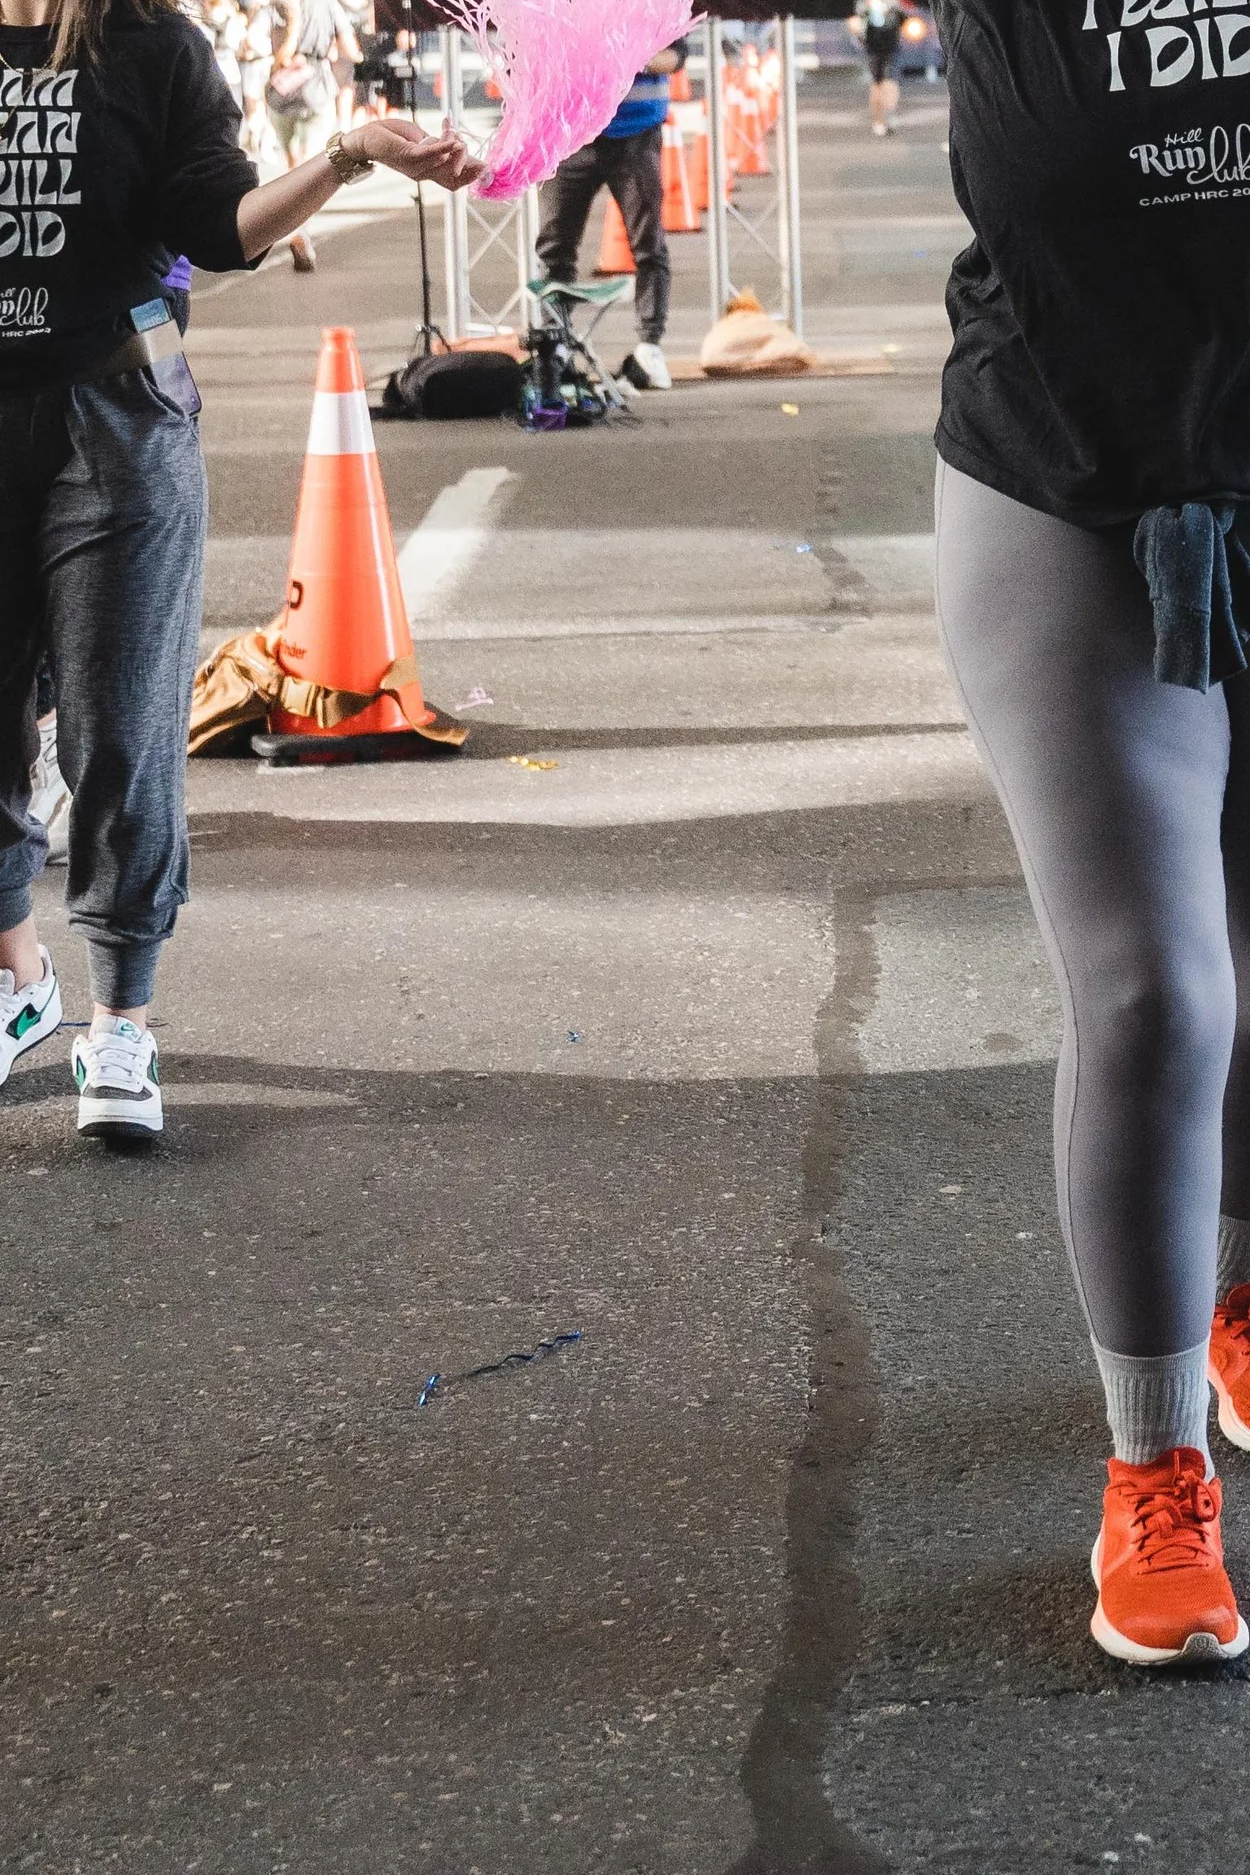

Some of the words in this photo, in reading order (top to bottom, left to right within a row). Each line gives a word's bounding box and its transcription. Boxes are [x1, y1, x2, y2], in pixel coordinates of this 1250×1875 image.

[1106, 31, 1126, 92] I
[0, 112, 82, 153] AN
[1164, 127, 1204, 148] Hill
[1129, 143, 1206, 177] Run
[1138, 192, 1192, 207] CAMP
[1194, 188, 1230, 201] HRC
